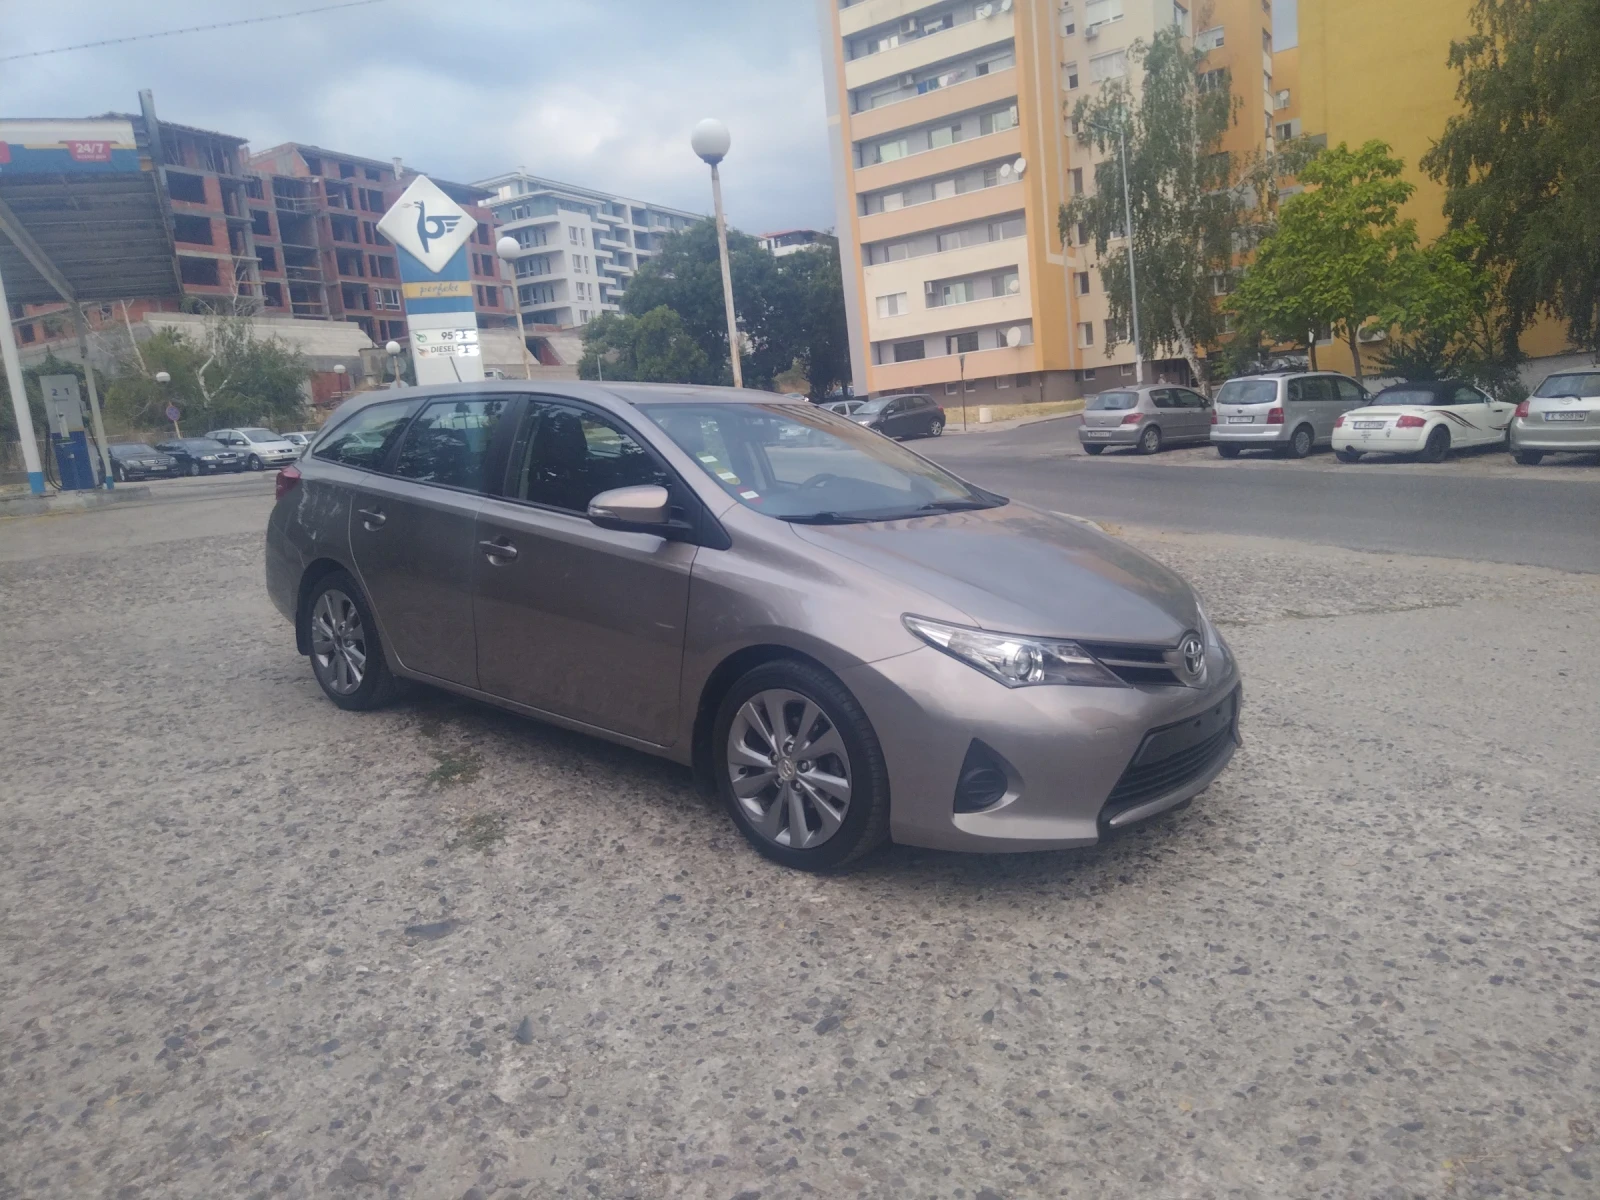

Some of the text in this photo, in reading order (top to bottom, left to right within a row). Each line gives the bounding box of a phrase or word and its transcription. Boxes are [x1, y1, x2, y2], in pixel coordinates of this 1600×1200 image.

[76, 143, 104, 154] 24/7
[441, 331, 454, 340] 95
[430, 345, 456, 353] DIESEL
[52, 388, 58, 396] 2
